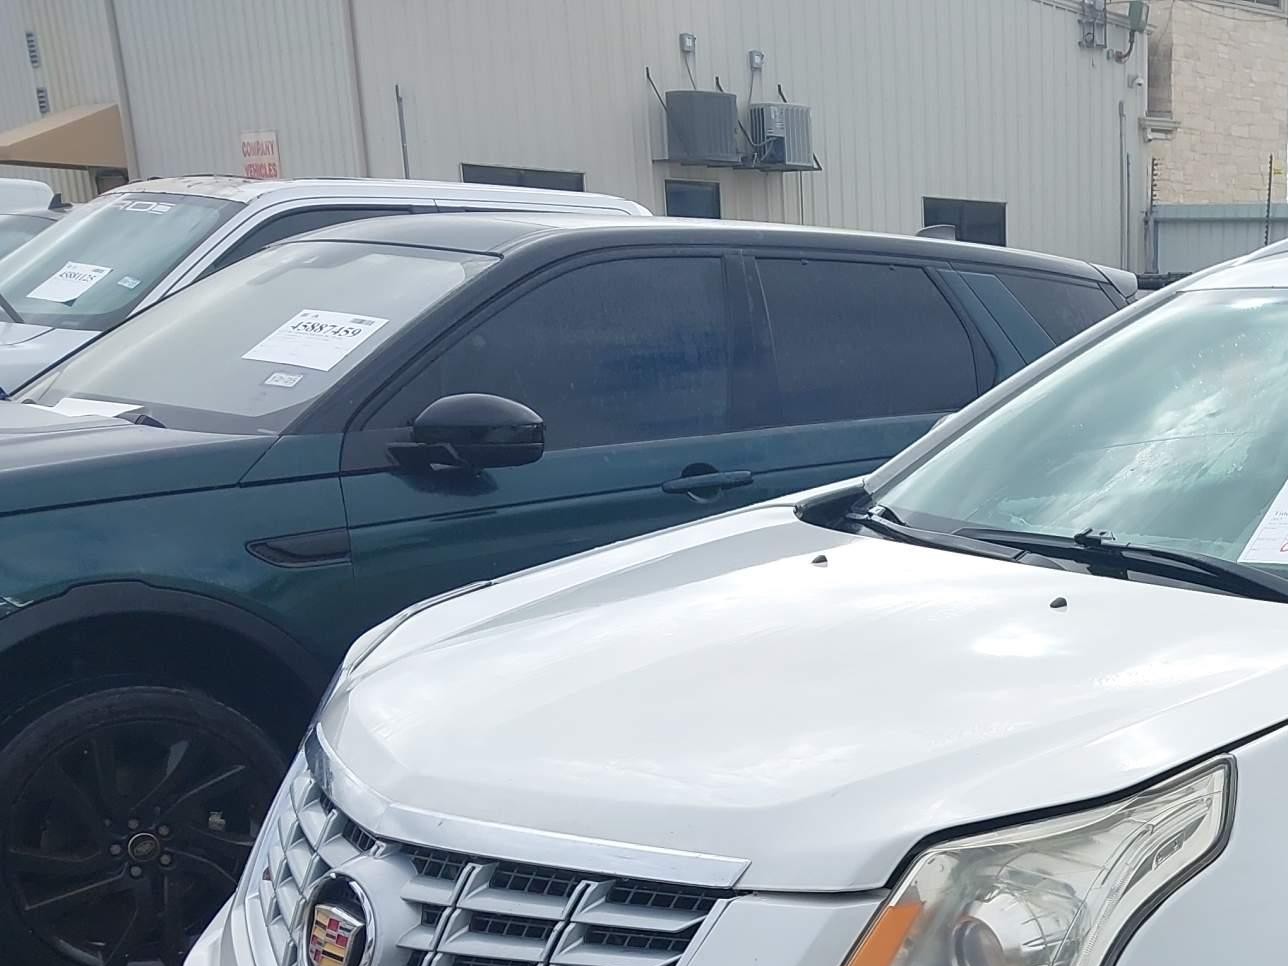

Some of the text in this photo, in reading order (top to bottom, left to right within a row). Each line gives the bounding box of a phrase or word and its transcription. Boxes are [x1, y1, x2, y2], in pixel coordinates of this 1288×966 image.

[242, 141, 275, 157] COMPANY
[245, 163, 278, 178] VEHICLES
[290, 321, 362, 337] 45887459
